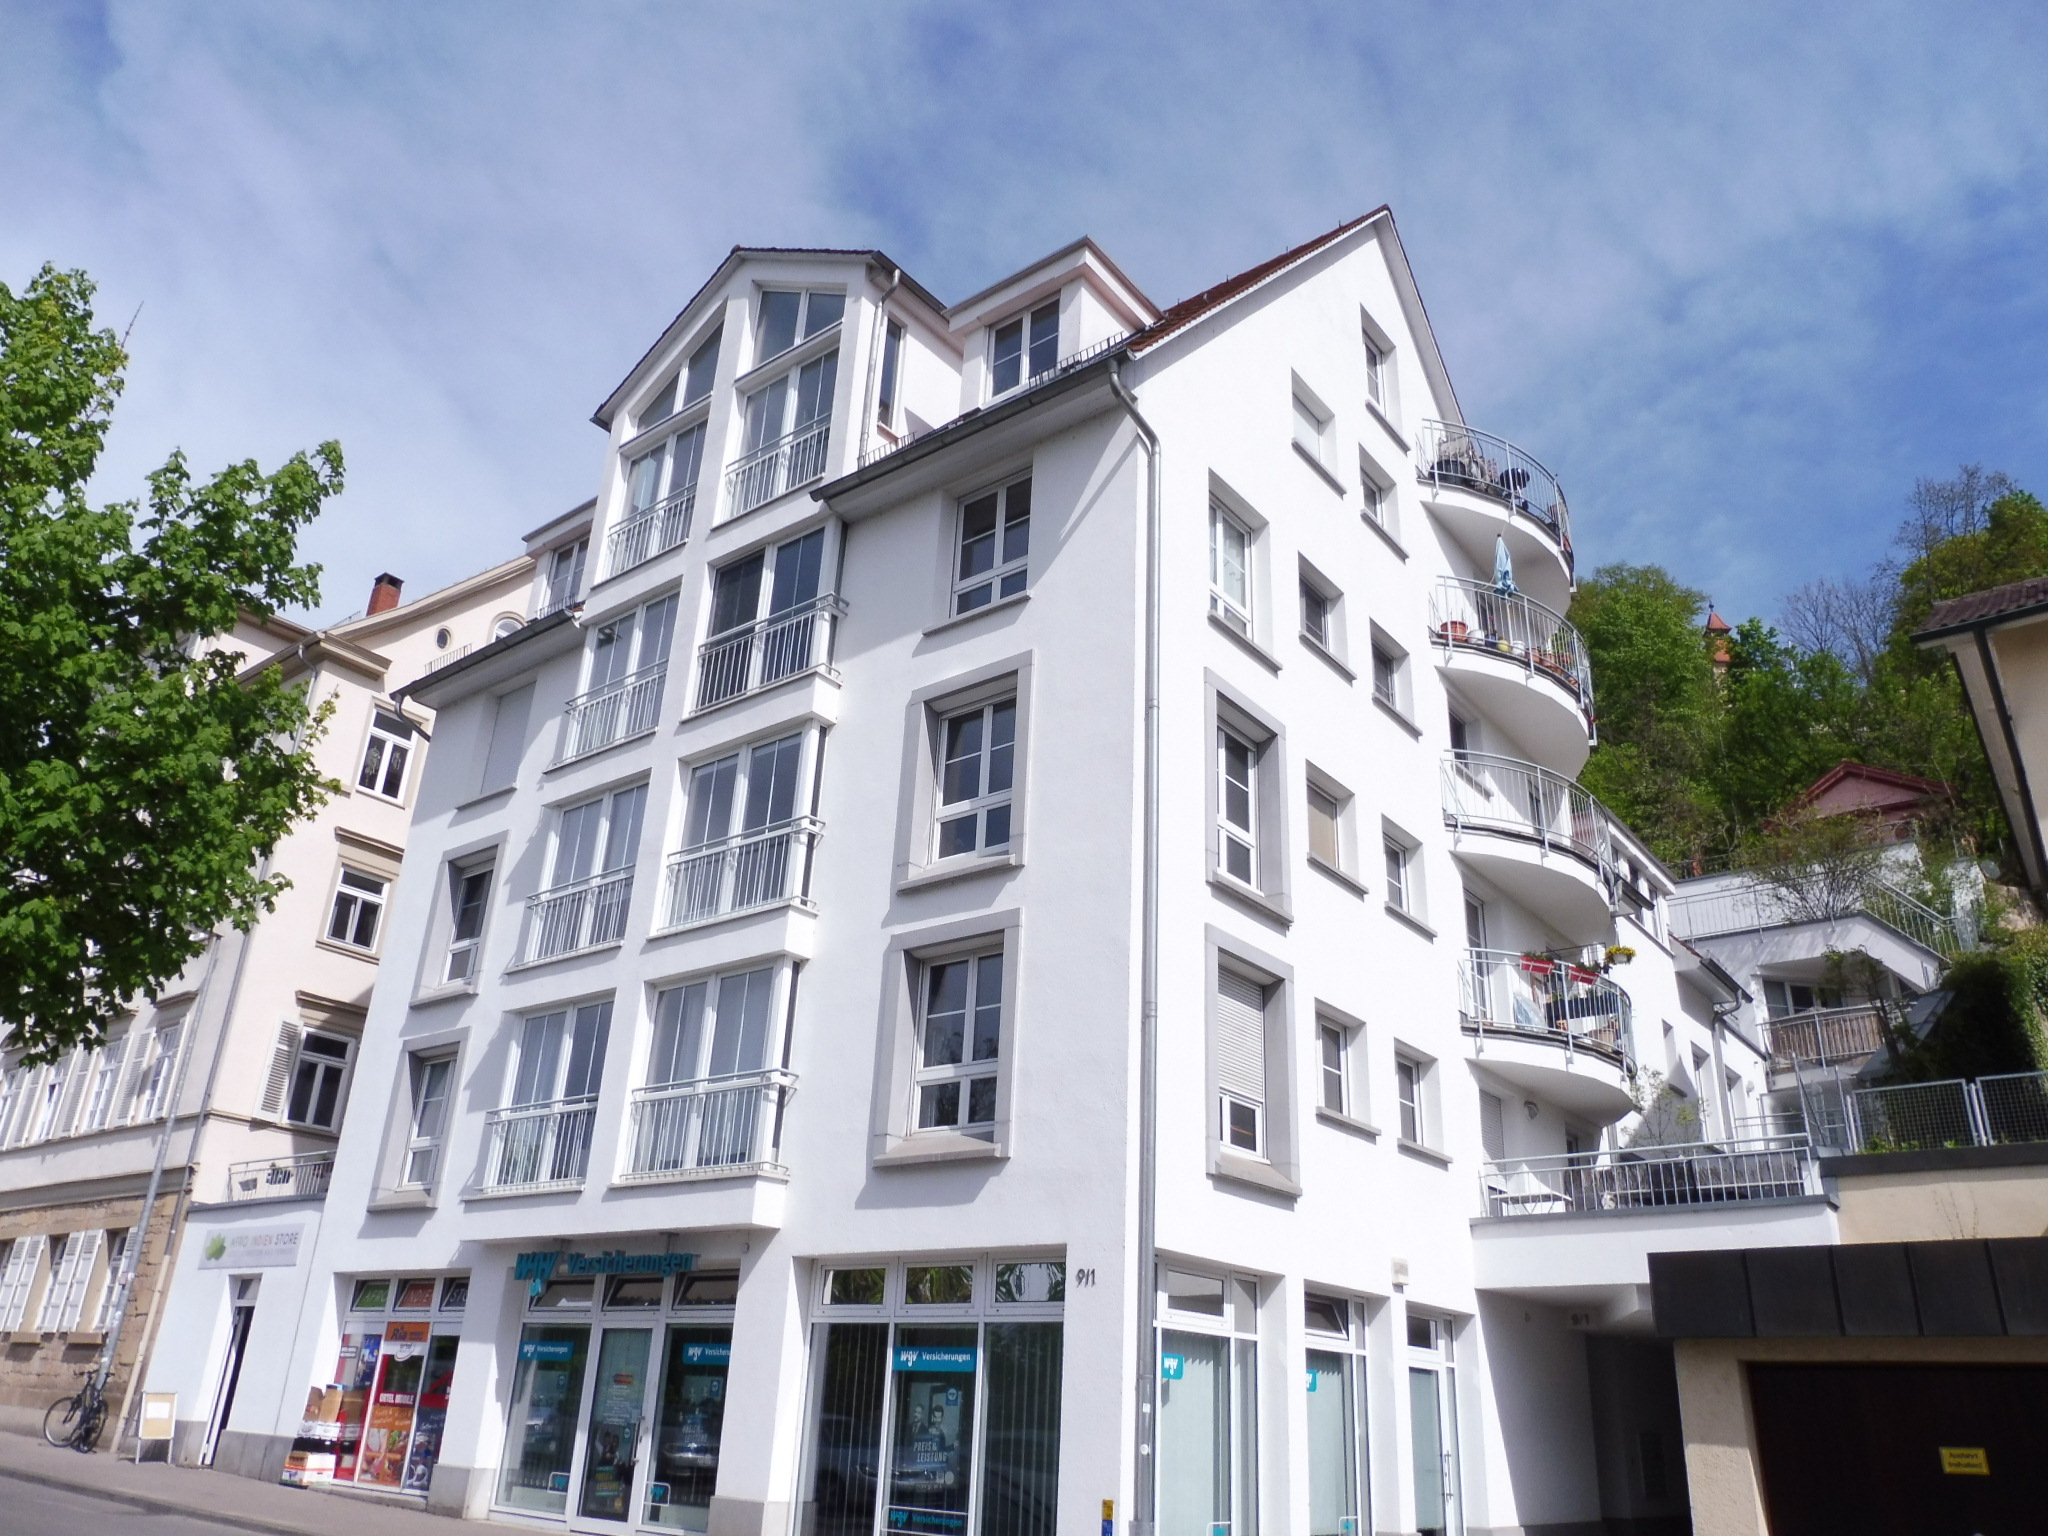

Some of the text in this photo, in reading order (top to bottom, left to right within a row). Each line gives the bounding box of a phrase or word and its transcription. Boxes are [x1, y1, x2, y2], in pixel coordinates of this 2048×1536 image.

[274, 1232, 298, 1246] STORE
[567, 1251, 692, 1277] Versicherungen
[922, 1351, 970, 1362] Versicherungen
